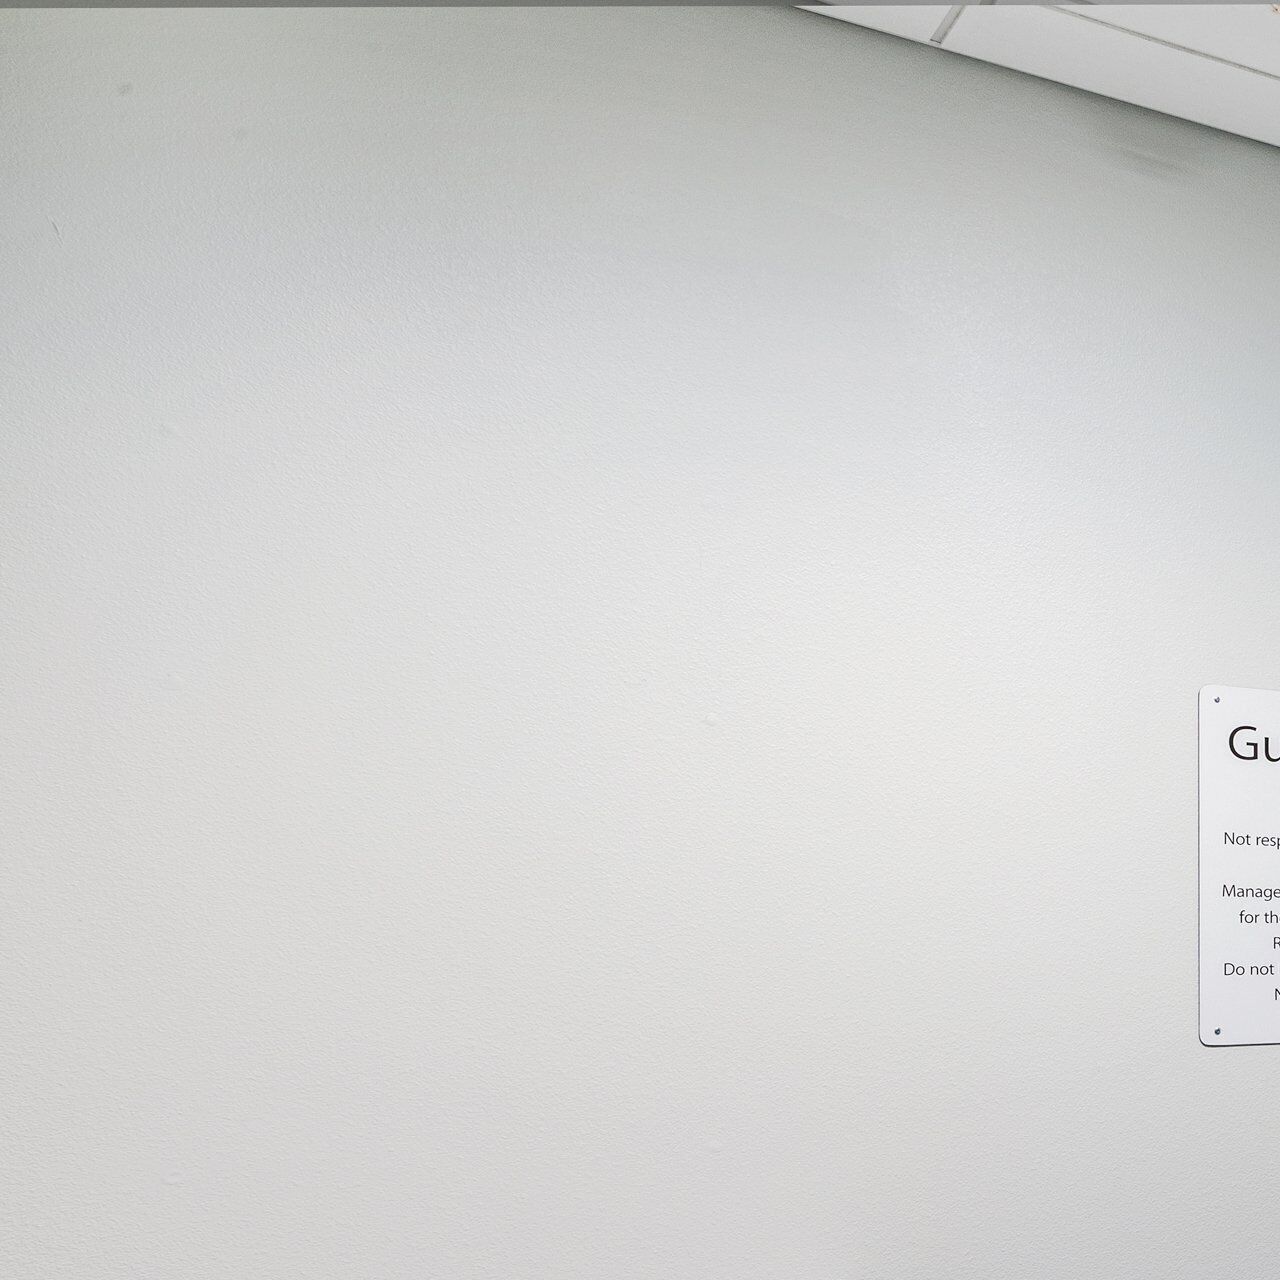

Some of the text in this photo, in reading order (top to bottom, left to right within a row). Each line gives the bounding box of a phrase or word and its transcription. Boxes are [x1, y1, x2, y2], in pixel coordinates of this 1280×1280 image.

[1224, 831, 1252, 846] Not
[1238, 909, 1260, 924] for
[1223, 962, 1246, 976] Do
[1250, 963, 1275, 976] not
